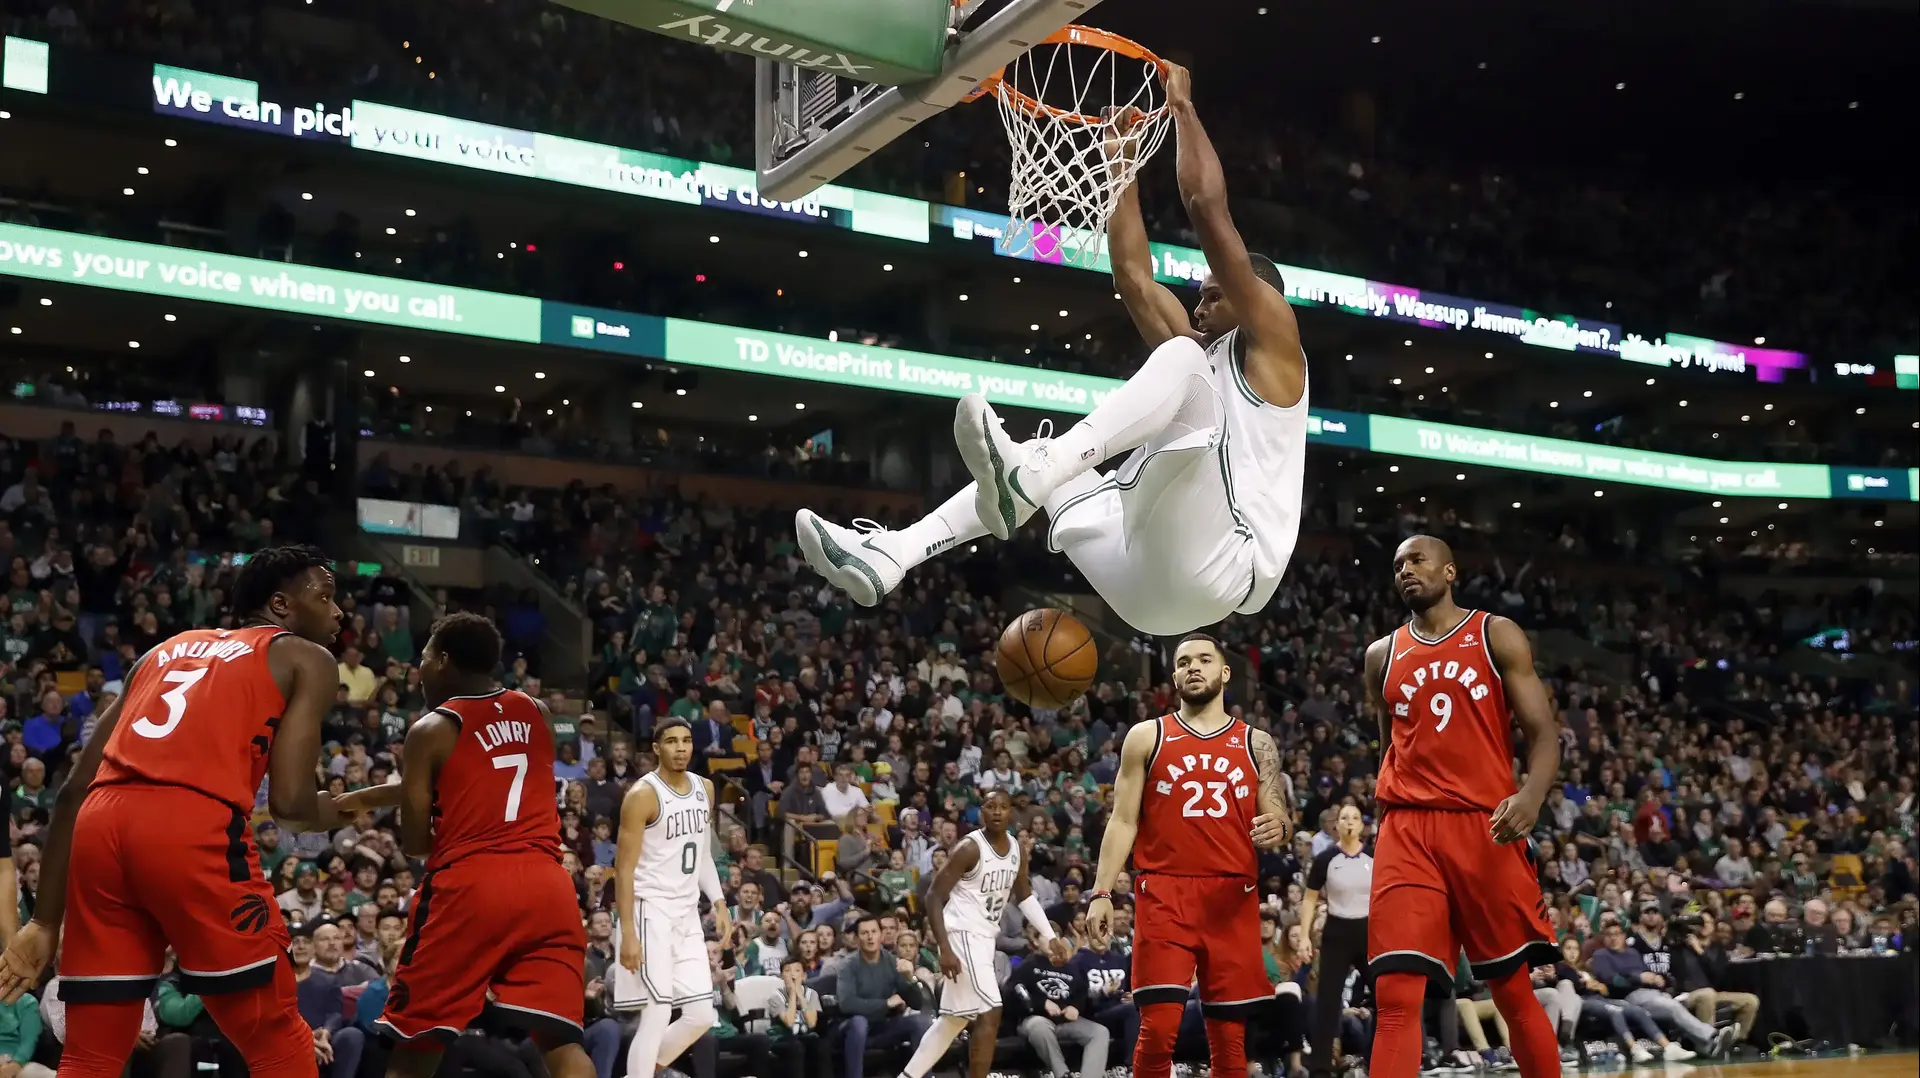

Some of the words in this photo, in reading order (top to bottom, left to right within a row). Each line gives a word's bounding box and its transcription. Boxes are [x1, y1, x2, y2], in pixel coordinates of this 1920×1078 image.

[658, 14, 874, 74] xfinity
[153, 76, 212, 112] We
[222, 96, 281, 125] can
[294, 102, 358, 137] pick
[72, 249, 150, 278] your
[158, 261, 242, 292] voice
[250, 271, 336, 305] when
[343, 287, 399, 314] you
[408, 294, 463, 322] call.
[1393, 292, 1469, 331] Wassup
[735, 337, 769, 363] TD
[775, 342, 893, 380] VoicePrint
[898, 358, 972, 391] knows
[977, 373, 1030, 397] your
[1031, 379, 1088, 405] voice
[1417, 427, 1443, 450] TD
[131, 667, 209, 739] 3
[1395, 660, 1489, 717] RAPTORS
[1430, 692, 1453, 733] 9
[474, 720, 532, 753] LOWRY
[491, 753, 528, 822] 7
[1156, 753, 1249, 800] RAPTORS
[1181, 780, 1229, 818] 23
[681, 841, 697, 875] 0
